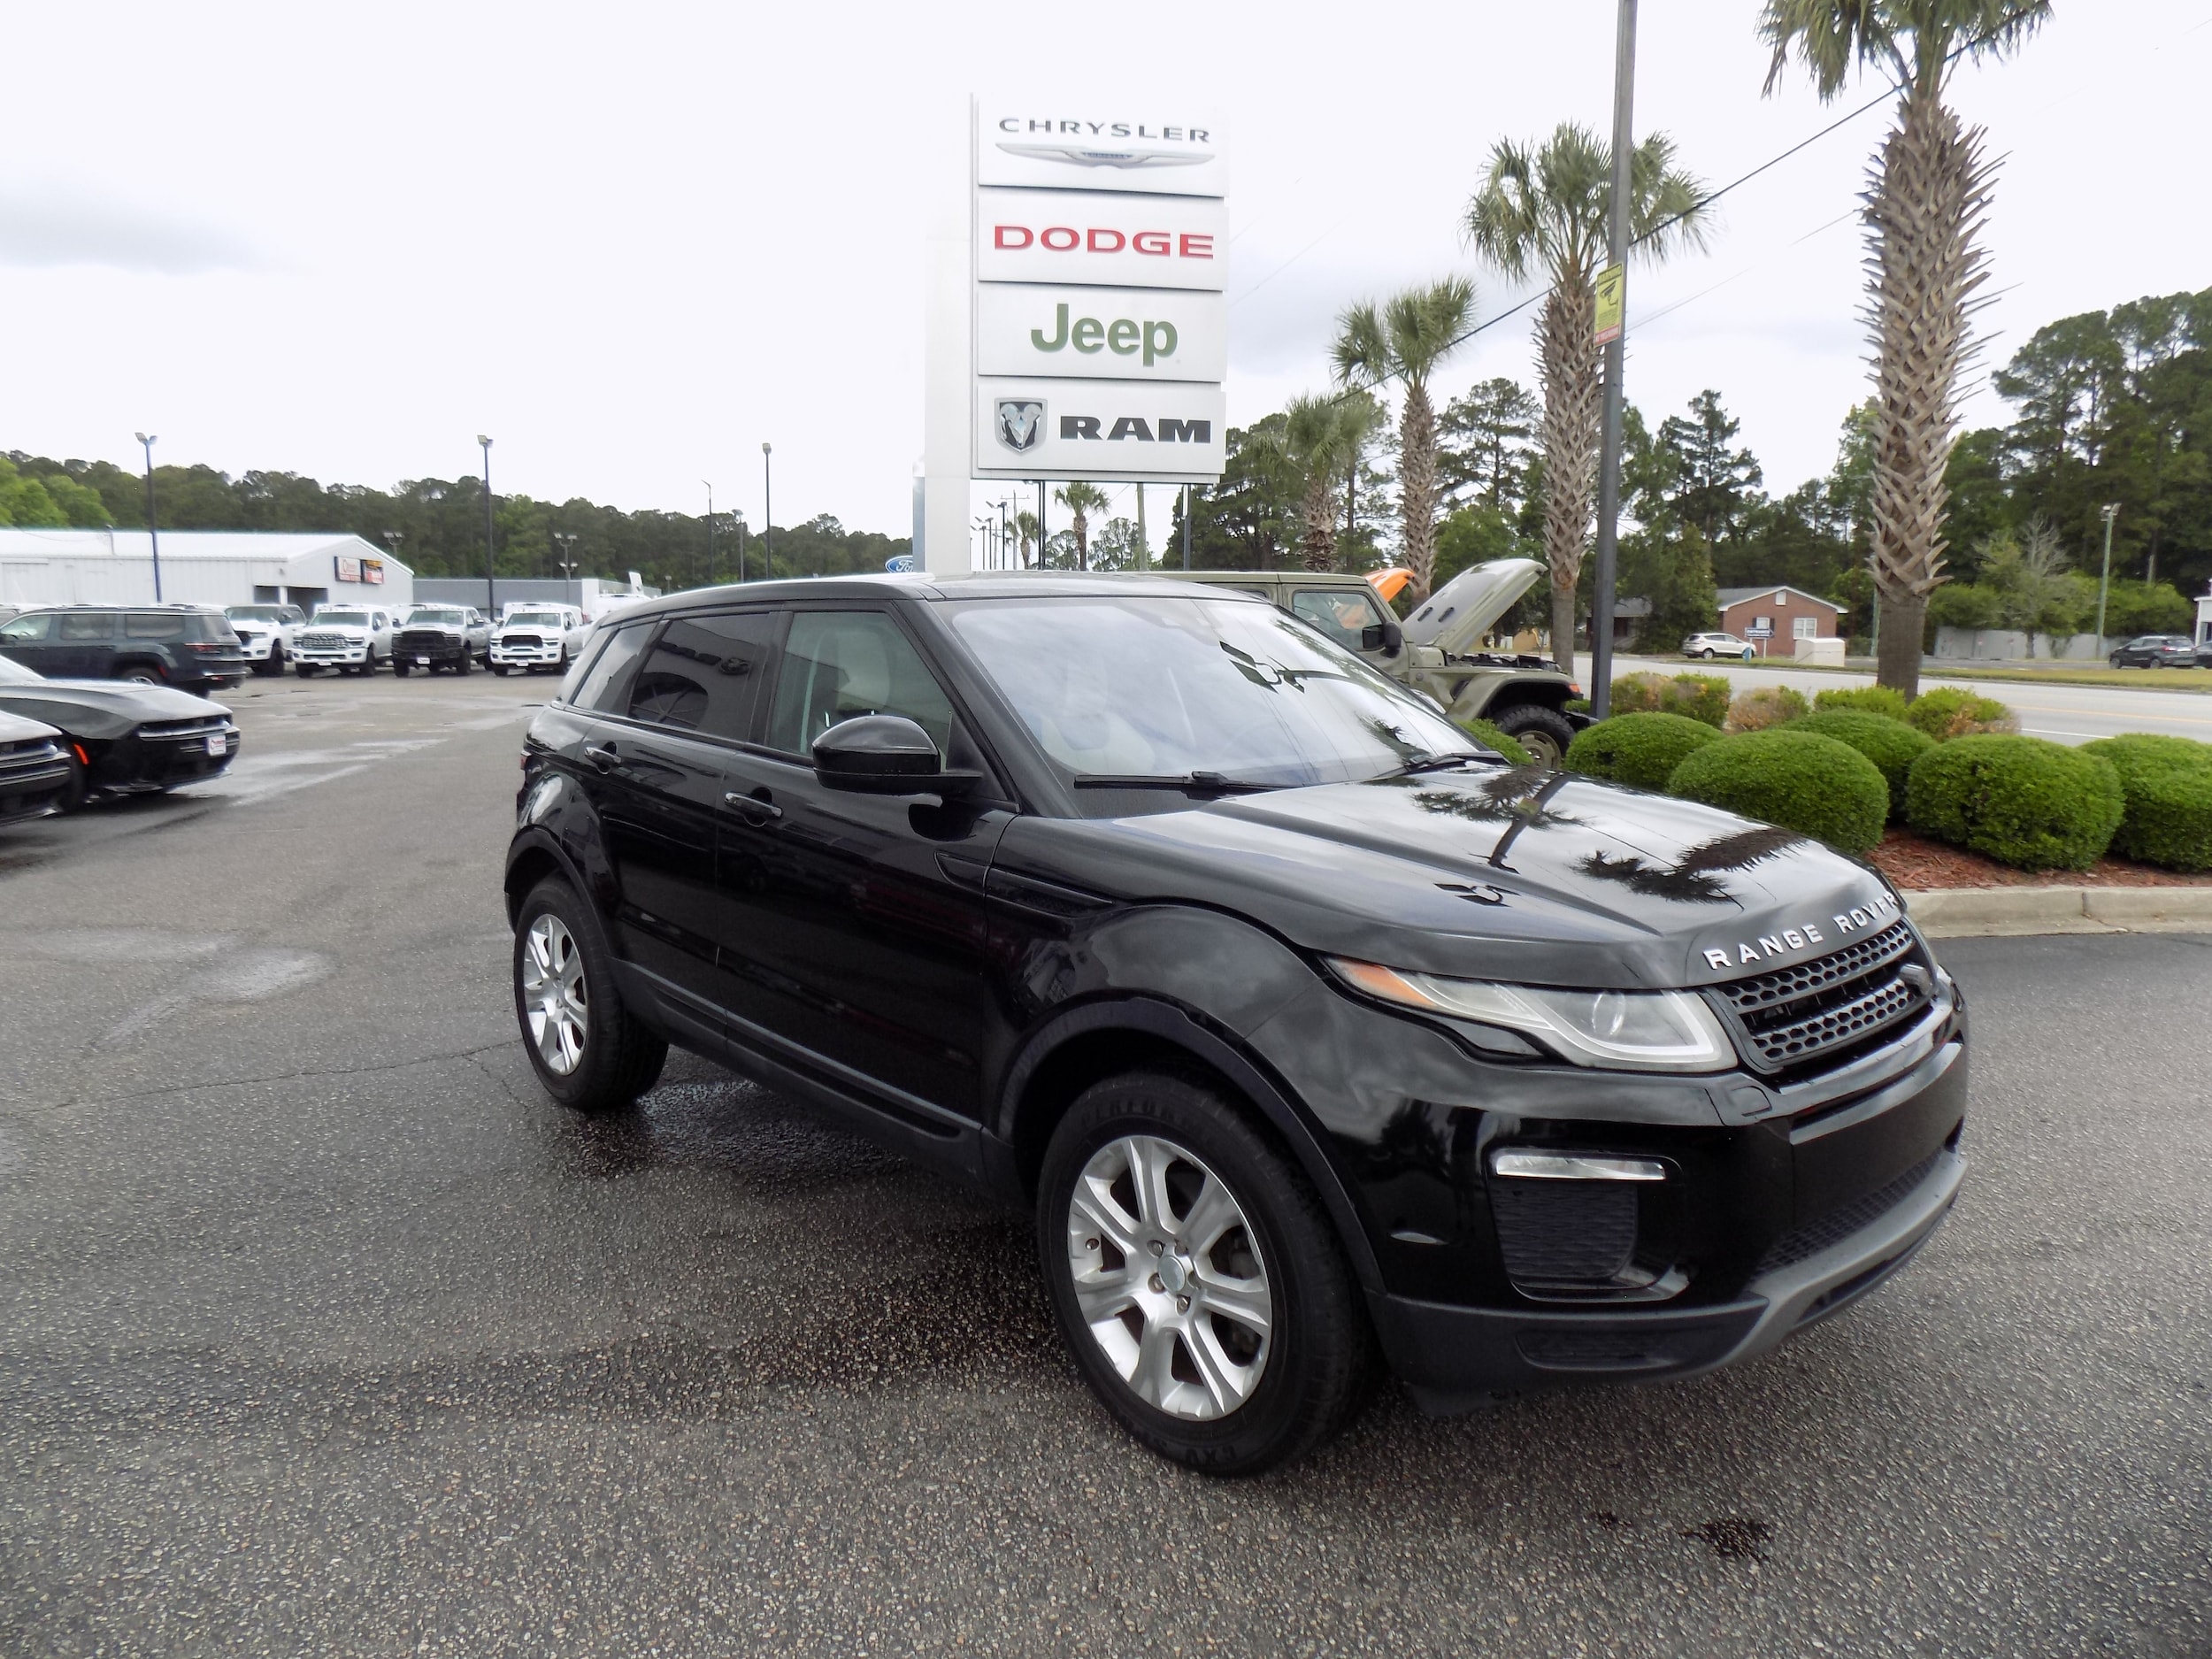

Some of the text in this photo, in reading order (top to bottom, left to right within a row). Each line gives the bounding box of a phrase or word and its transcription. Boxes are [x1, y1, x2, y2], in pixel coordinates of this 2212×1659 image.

[999, 118, 1210, 142] CHRYSLER
[995, 225, 1214, 259] DODGE
[1031, 303, 1178, 367] Jeep
[1060, 416, 1211, 443] RAM
[1702, 924, 1824, 970] RANGE
